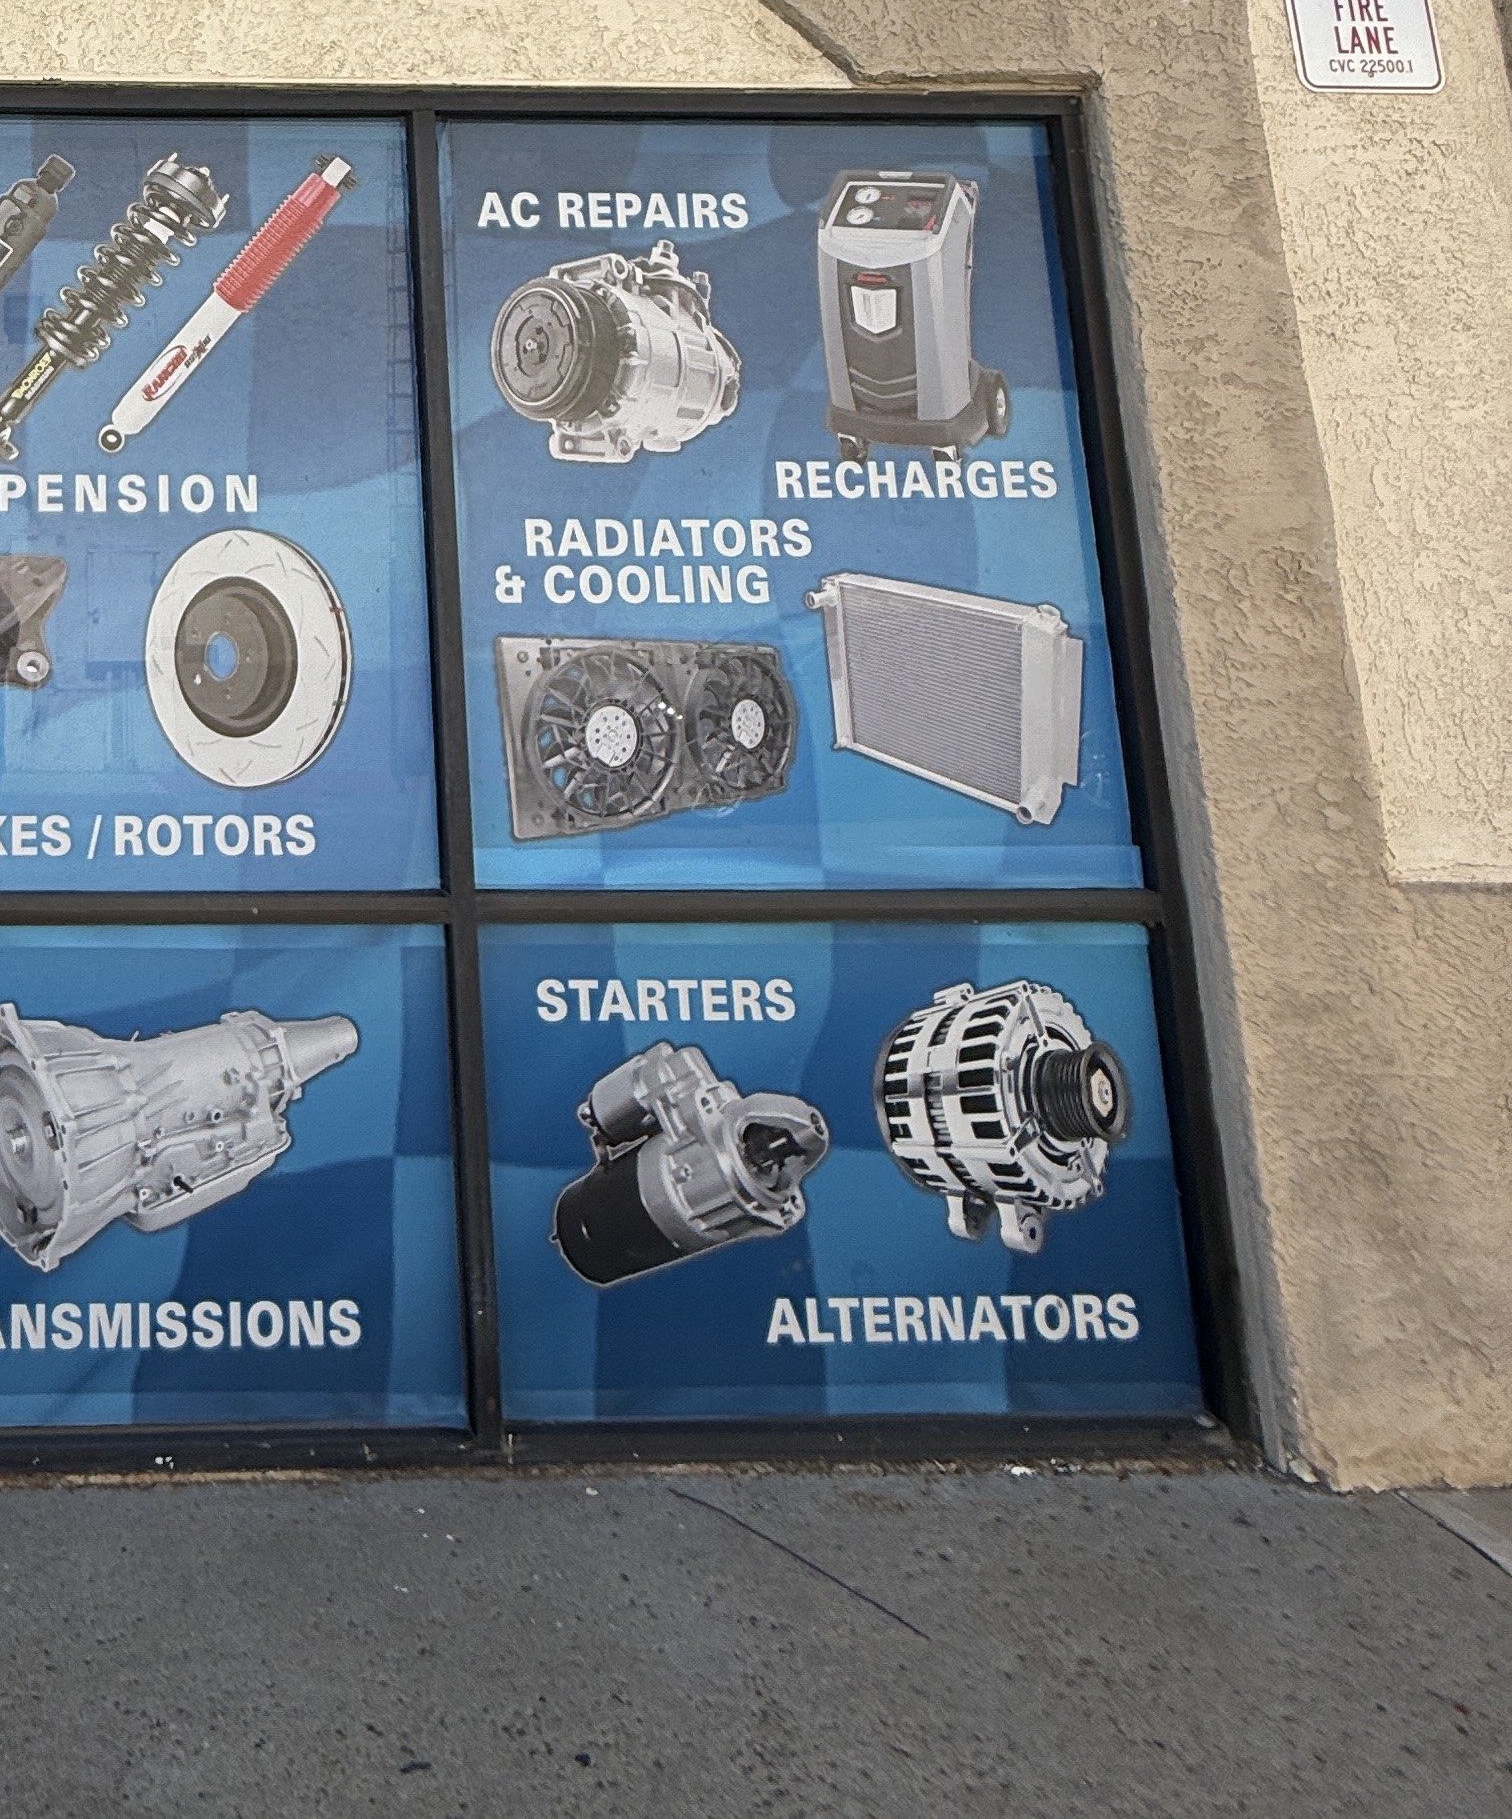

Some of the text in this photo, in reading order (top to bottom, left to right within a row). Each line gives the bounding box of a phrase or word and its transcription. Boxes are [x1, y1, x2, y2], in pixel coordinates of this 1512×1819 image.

[1334, 26, 1399, 55] LANE
[1329, 59, 1356, 73] CVC
[478, 191, 750, 230] AC REPAIRS
[775, 460, 1058, 500] RECHARGES
[525, 518, 812, 558] RADIATORS
[494, 564, 771, 605] & COOLING
[87, 813, 103, 859] /
[113, 813, 317, 858] ROTORS
[536, 978, 797, 1023] STARTERS
[766, 1293, 1140, 1345] ALTERNATORS
